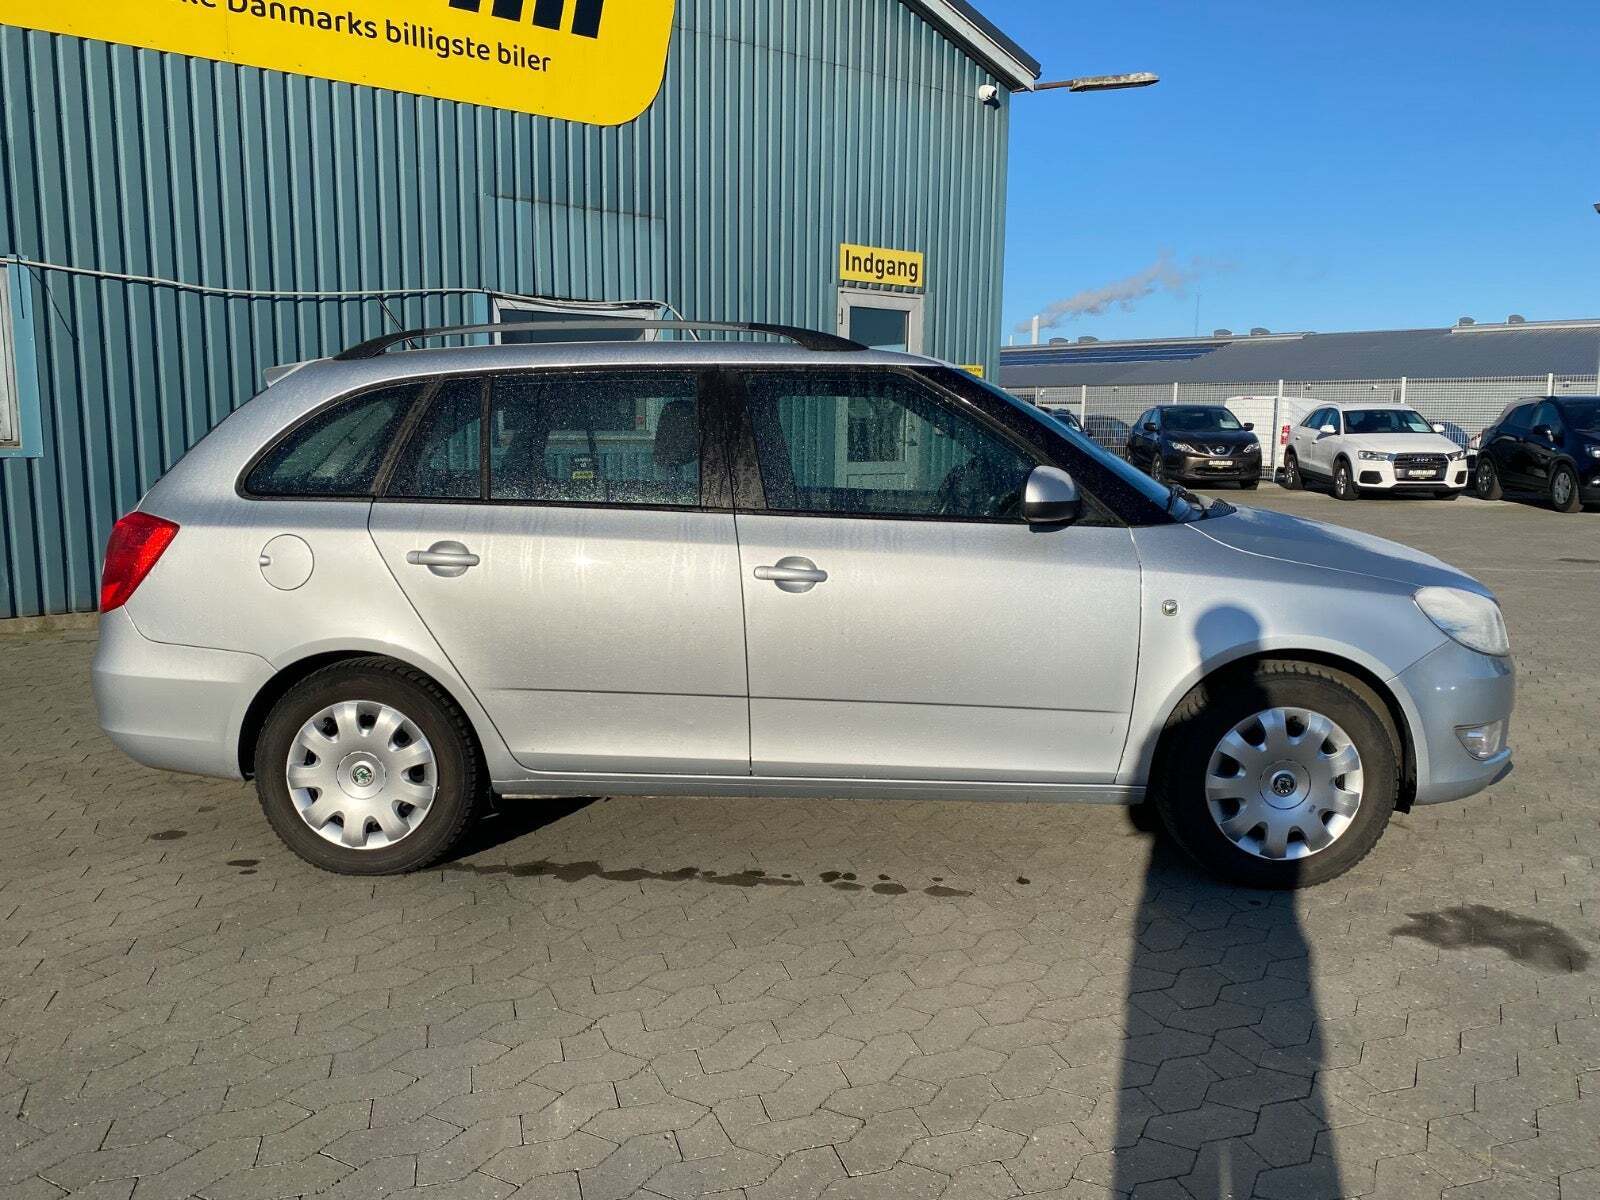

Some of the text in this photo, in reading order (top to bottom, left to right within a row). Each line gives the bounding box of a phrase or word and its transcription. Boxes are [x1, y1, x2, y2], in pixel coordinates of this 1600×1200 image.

[228, 0, 551, 72] Danmarks billigste biler
[845, 249, 918, 283] Indgang
